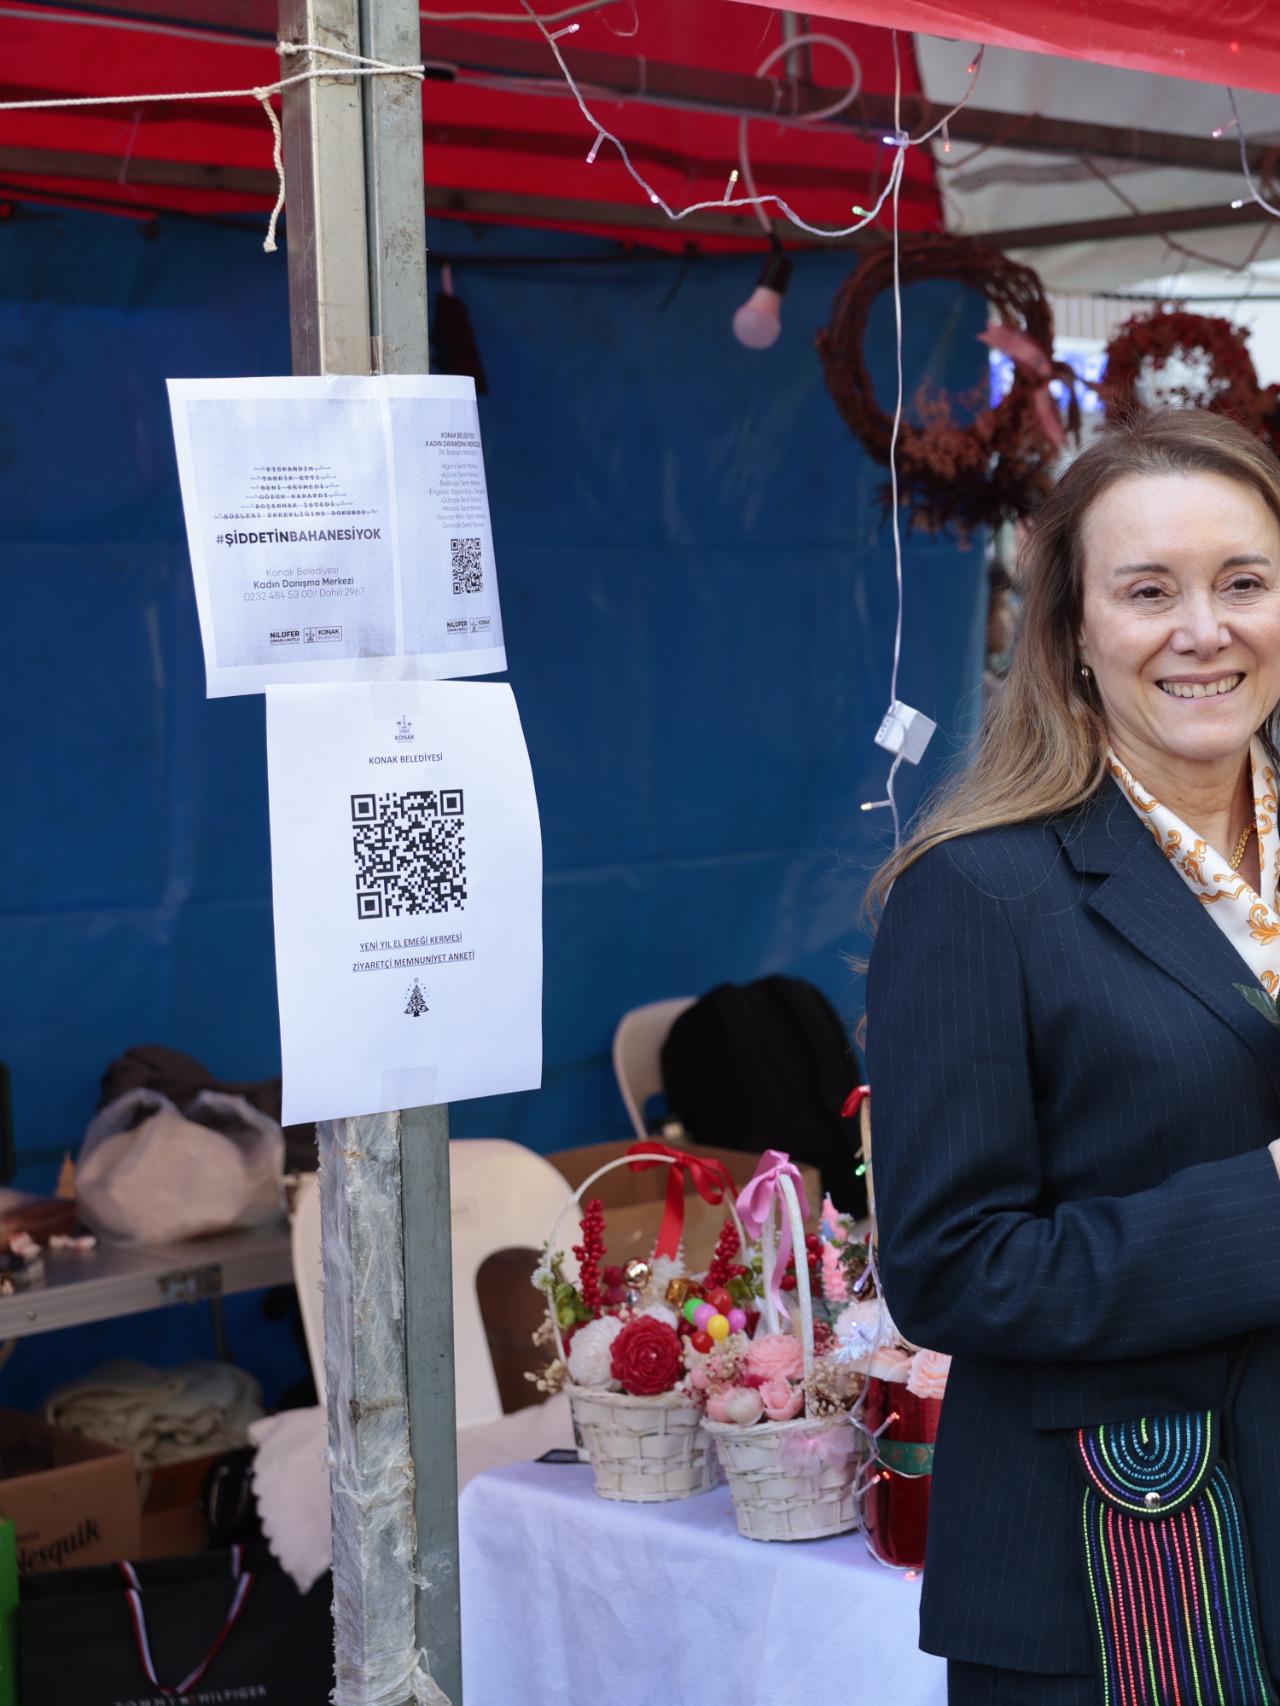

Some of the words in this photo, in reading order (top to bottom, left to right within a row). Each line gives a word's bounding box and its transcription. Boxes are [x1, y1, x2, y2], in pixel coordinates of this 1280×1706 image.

[216, 526, 381, 547] #ŞİDDETİNBAHANESİYOK
[266, 568, 295, 577] Konak
[296, 565, 339, 577] Belediyesi
[253, 580, 280, 589] Kadın
[282, 579, 320, 589] Danışma
[322, 576, 354, 586] Merkezi
[243, 592, 267, 601] 0232
[269, 591, 286, 600] 484
[288, 590, 299, 599] 53
[368, 755, 398, 765] KONAK
[400, 752, 443, 764] BELEDİYESİ
[359, 940, 378, 951] YENİ
[380, 940, 392, 949] YIL
[393, 940, 402, 948] EL
[403, 936, 428, 947] EMEĞİ
[430, 931, 463, 944] KERMESİ
[352, 957, 393, 972] ZİYARETÇİ
[394, 953, 447, 968] MEMNUNİYET
[448, 949, 475, 961] ANKETİ
